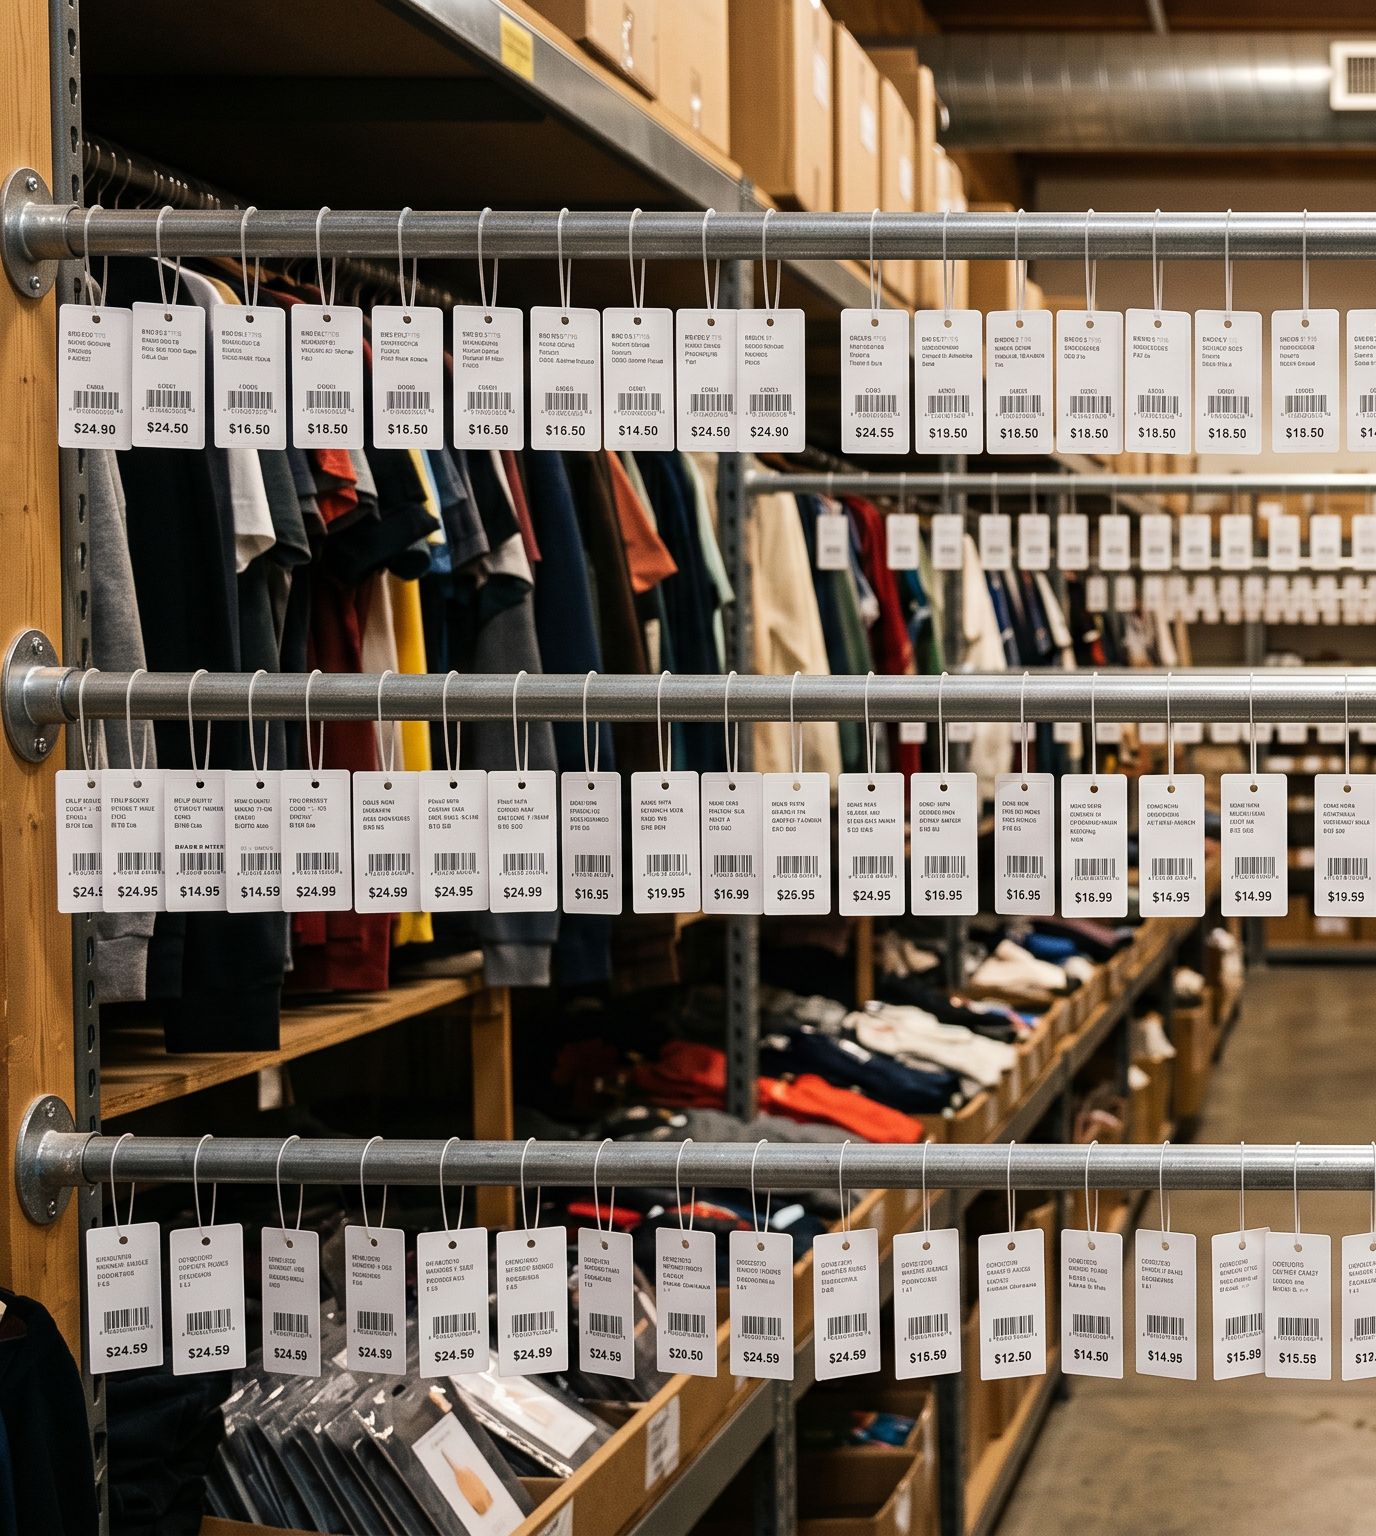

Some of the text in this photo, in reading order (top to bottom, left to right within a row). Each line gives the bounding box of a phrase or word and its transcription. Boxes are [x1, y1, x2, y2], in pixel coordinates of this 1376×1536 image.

[73, 422, 116, 435] $24.90
[146, 421, 189, 434] $24.50
[228, 422, 271, 435] $16.50
[307, 422, 349, 435] $18.50
[468, 423, 509, 436] $16.50
[618, 424, 659, 437] $14.50
[690, 425, 731, 438] $24.50
[750, 425, 789, 439] $24.90
[855, 426, 895, 439] $24.55
[1070, 427, 1109, 439] $18.50
[1138, 426, 1176, 439] $18.50
[117, 885, 159, 899] $24.95
[179, 885, 220, 899] $14.95
[240, 885, 281, 899] $14.59
[296, 885, 337, 899] $24.99
[434, 885, 474, 899] $24.95
[503, 886, 543, 900] $24.99
[574, 887, 609, 900] $16.95
[647, 887, 686, 901] $19.95
[713, 887, 750, 901] $16.99
[852, 889, 891, 903] $24.95
[1006, 888, 1041, 901] $16.95
[1234, 890, 1272, 903] $14.99
[1327, 890, 1365, 903] $19.59
[106, 1342, 148, 1359] $24.59
[188, 1344, 230, 1360] $24.59
[273, 1347, 308, 1361] $24.59
[434, 1347, 475, 1363] $24.59
[589, 1347, 622, 1362] $24.59
[668, 1347, 704, 1361] $20.50
[743, 1350, 780, 1364] $24.59
[828, 1348, 867, 1365] $24.59
[994, 1350, 1032, 1365] $12.50
[1073, 1348, 1109, 1363] $14.50
[1147, 1349, 1183, 1364] $14.95
